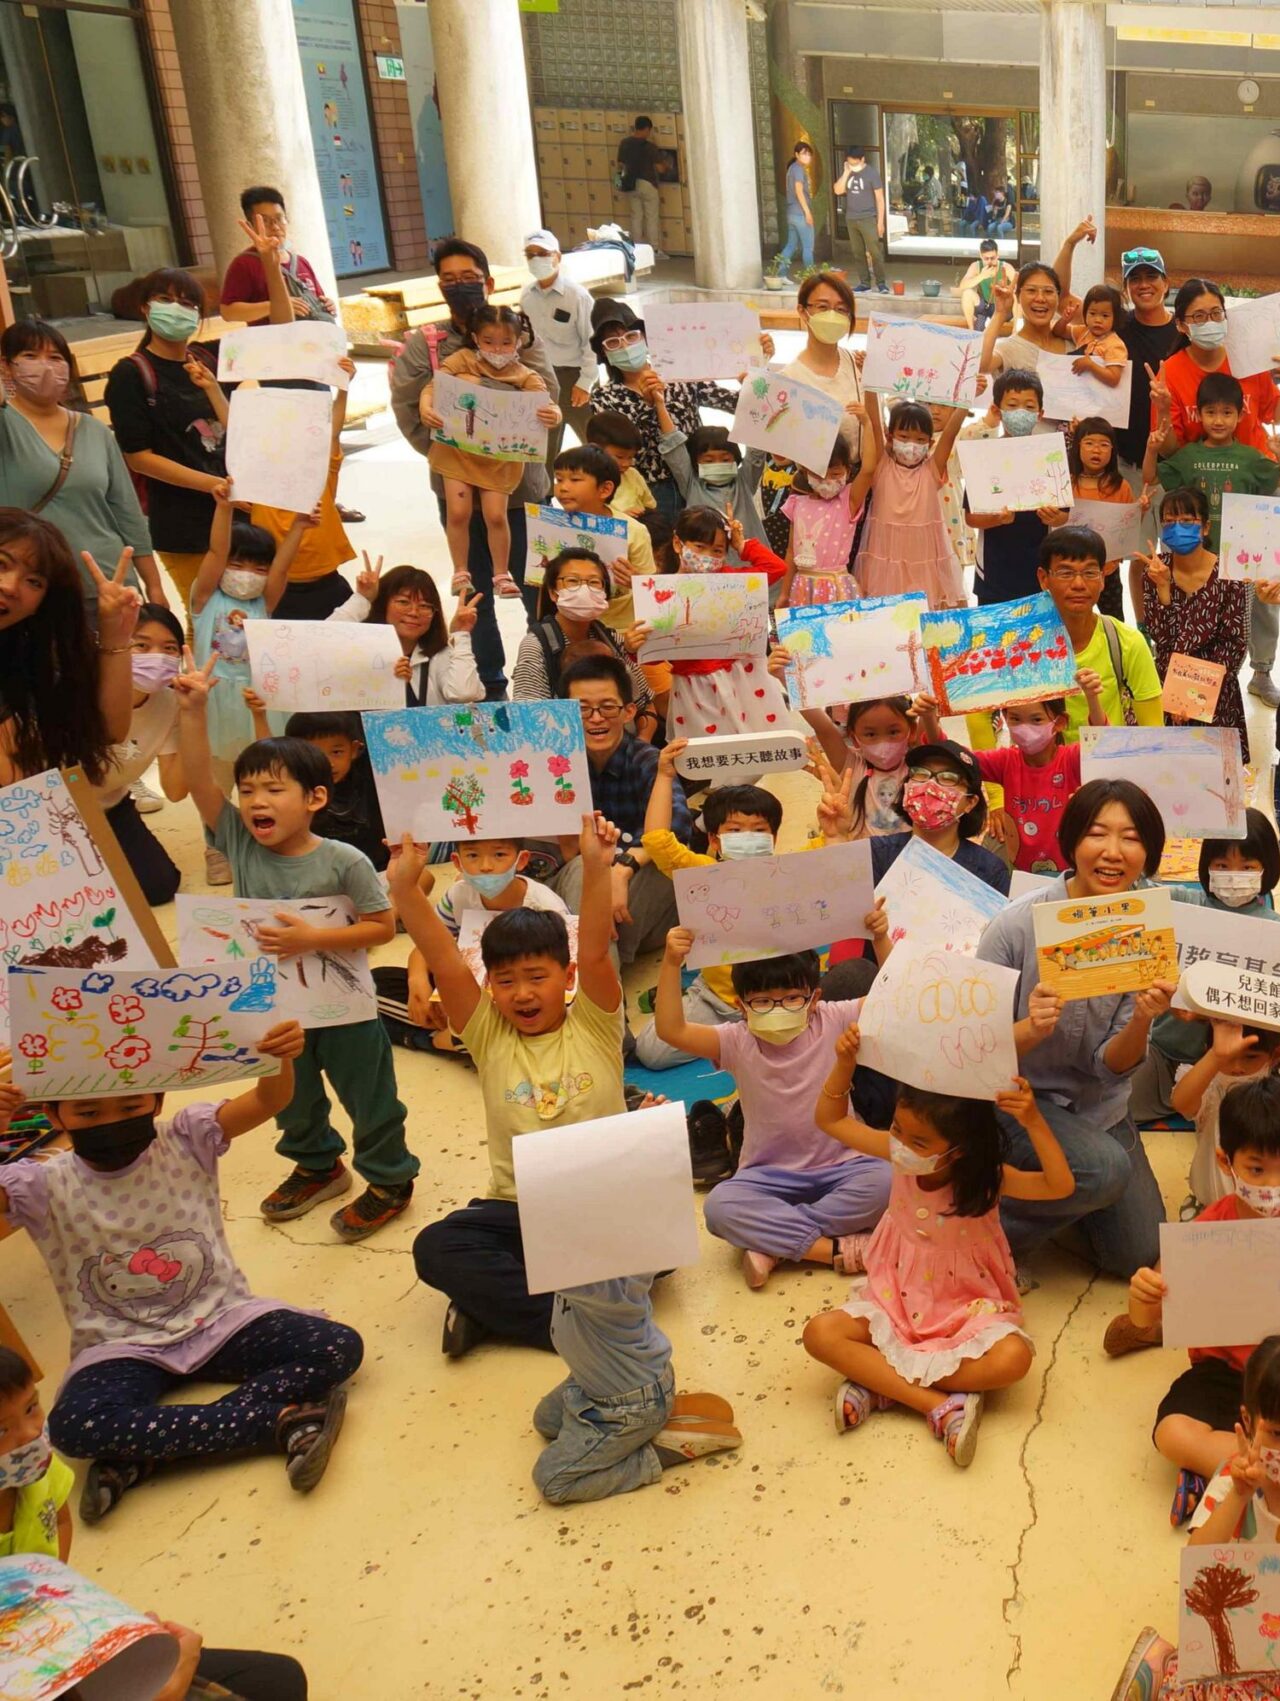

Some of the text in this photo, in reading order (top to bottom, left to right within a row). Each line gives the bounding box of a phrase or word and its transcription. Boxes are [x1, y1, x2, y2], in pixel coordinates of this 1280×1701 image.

[686, 747, 802, 770] 我想要天天聽故事
